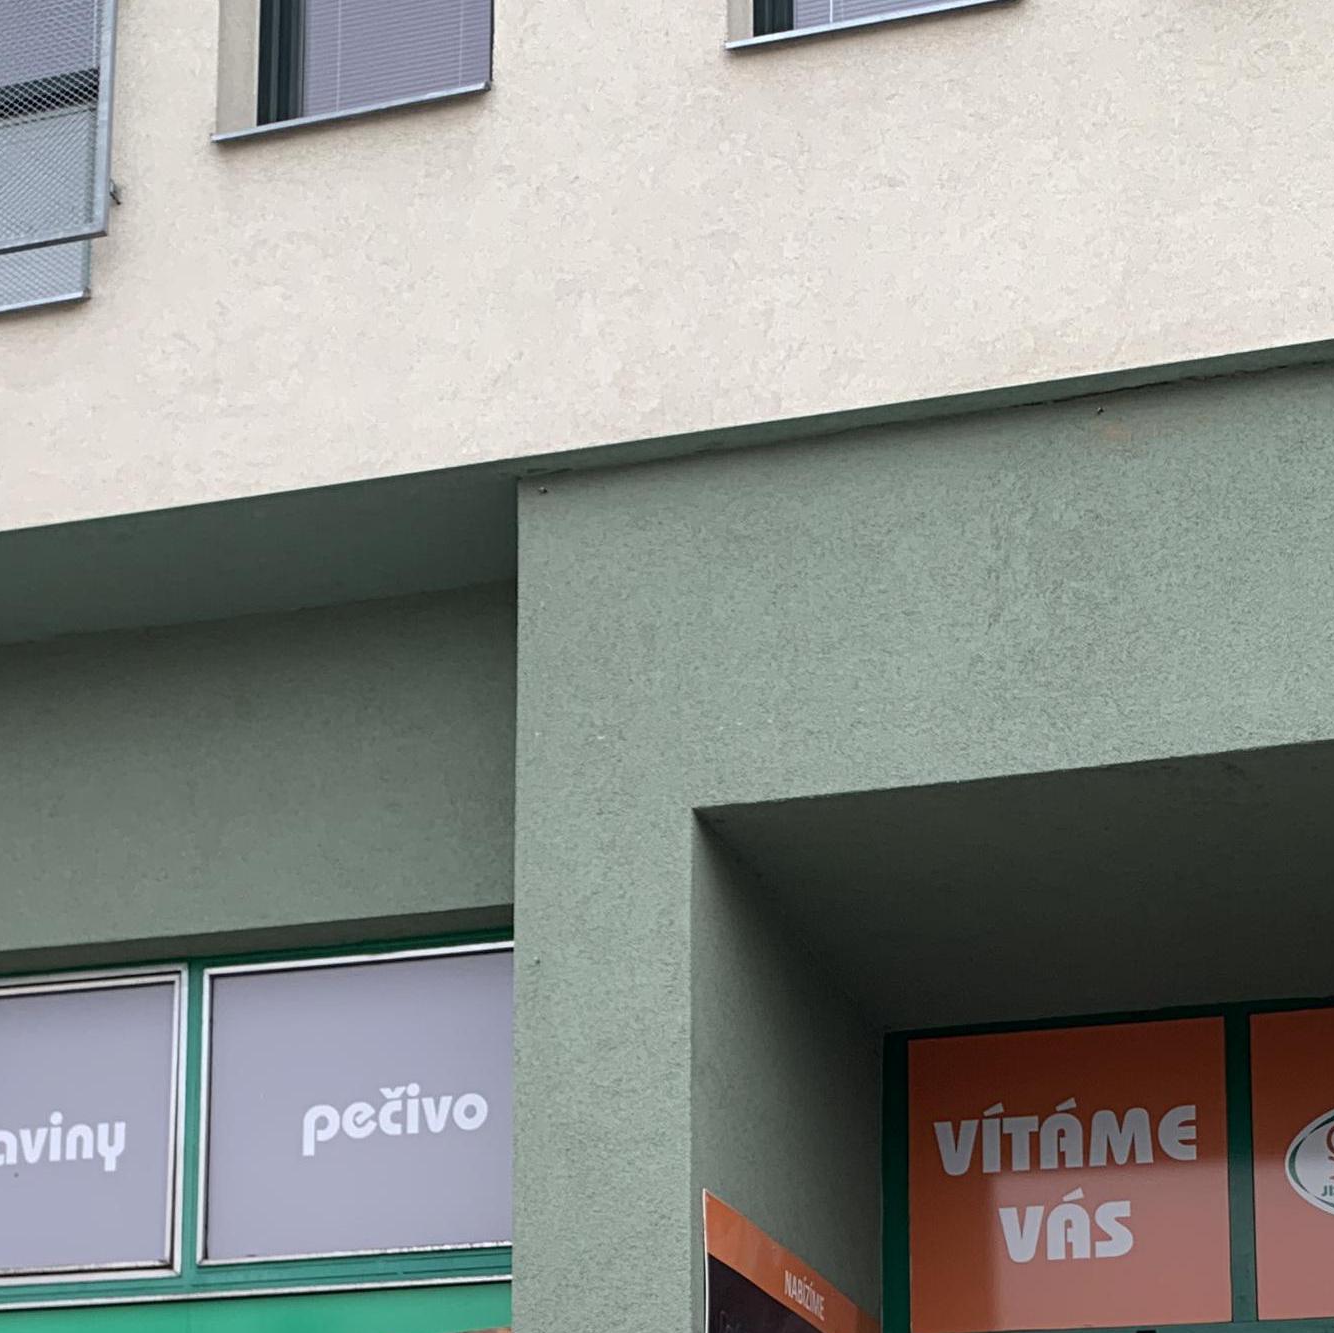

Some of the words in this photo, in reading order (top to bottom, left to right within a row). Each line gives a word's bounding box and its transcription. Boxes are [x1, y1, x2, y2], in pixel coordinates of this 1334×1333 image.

[303, 1083, 488, 1156] pečivo
[933, 1097, 1197, 1176] VÍTÁME
[998, 1187, 1133, 1262] VÁS
[784, 1269, 825, 1321] NABÍZÍME
